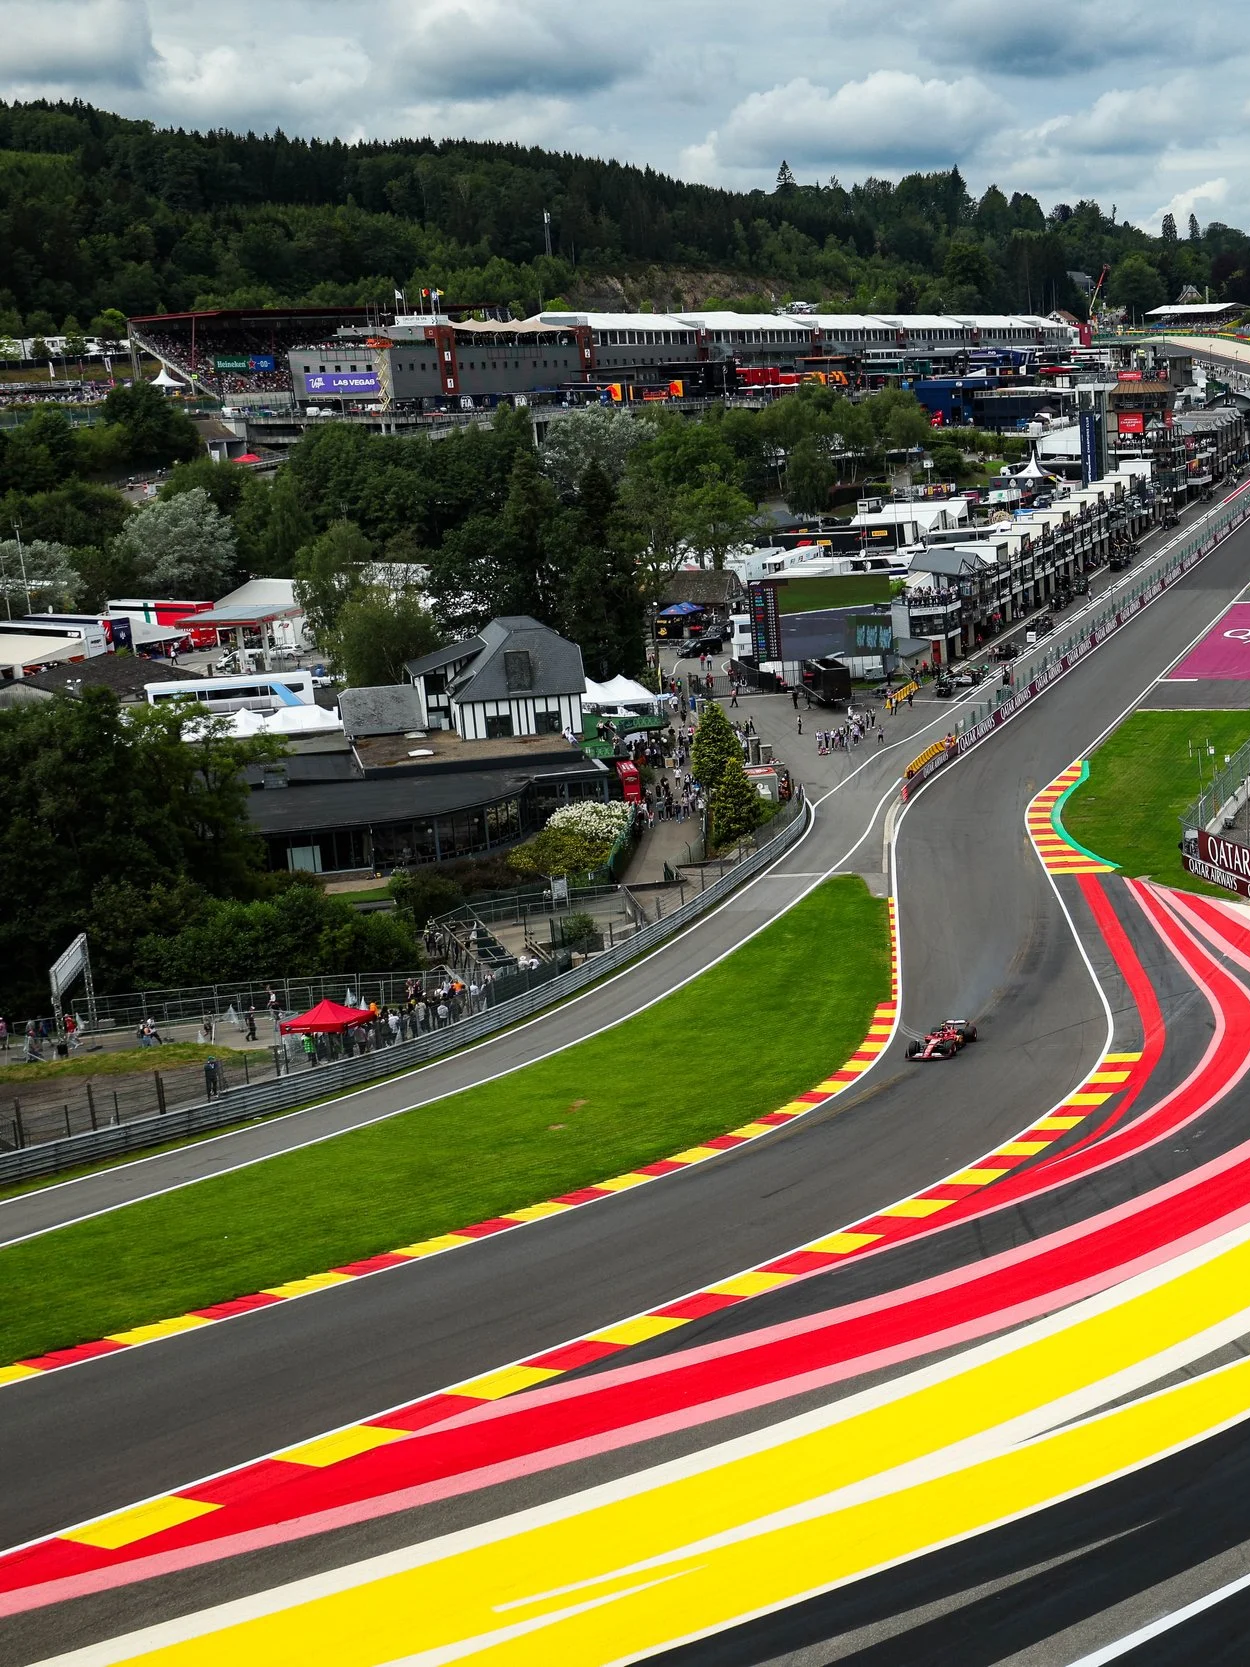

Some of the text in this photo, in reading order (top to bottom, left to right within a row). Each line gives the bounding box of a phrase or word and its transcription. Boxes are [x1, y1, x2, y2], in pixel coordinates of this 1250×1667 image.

[349, 378, 375, 386] VEGAS
[461, 397, 472, 408] FIA
[1035, 661, 1064, 692] QATAR AIRWAYS
[1000, 687, 1032, 720] QATAR AIRWAYS
[960, 715, 996, 751] QATAR AIRWAYS
[923, 752, 949, 778] QATAR AIRWAYS
[1188, 858, 1238, 891] QATAR AIRWAYS
